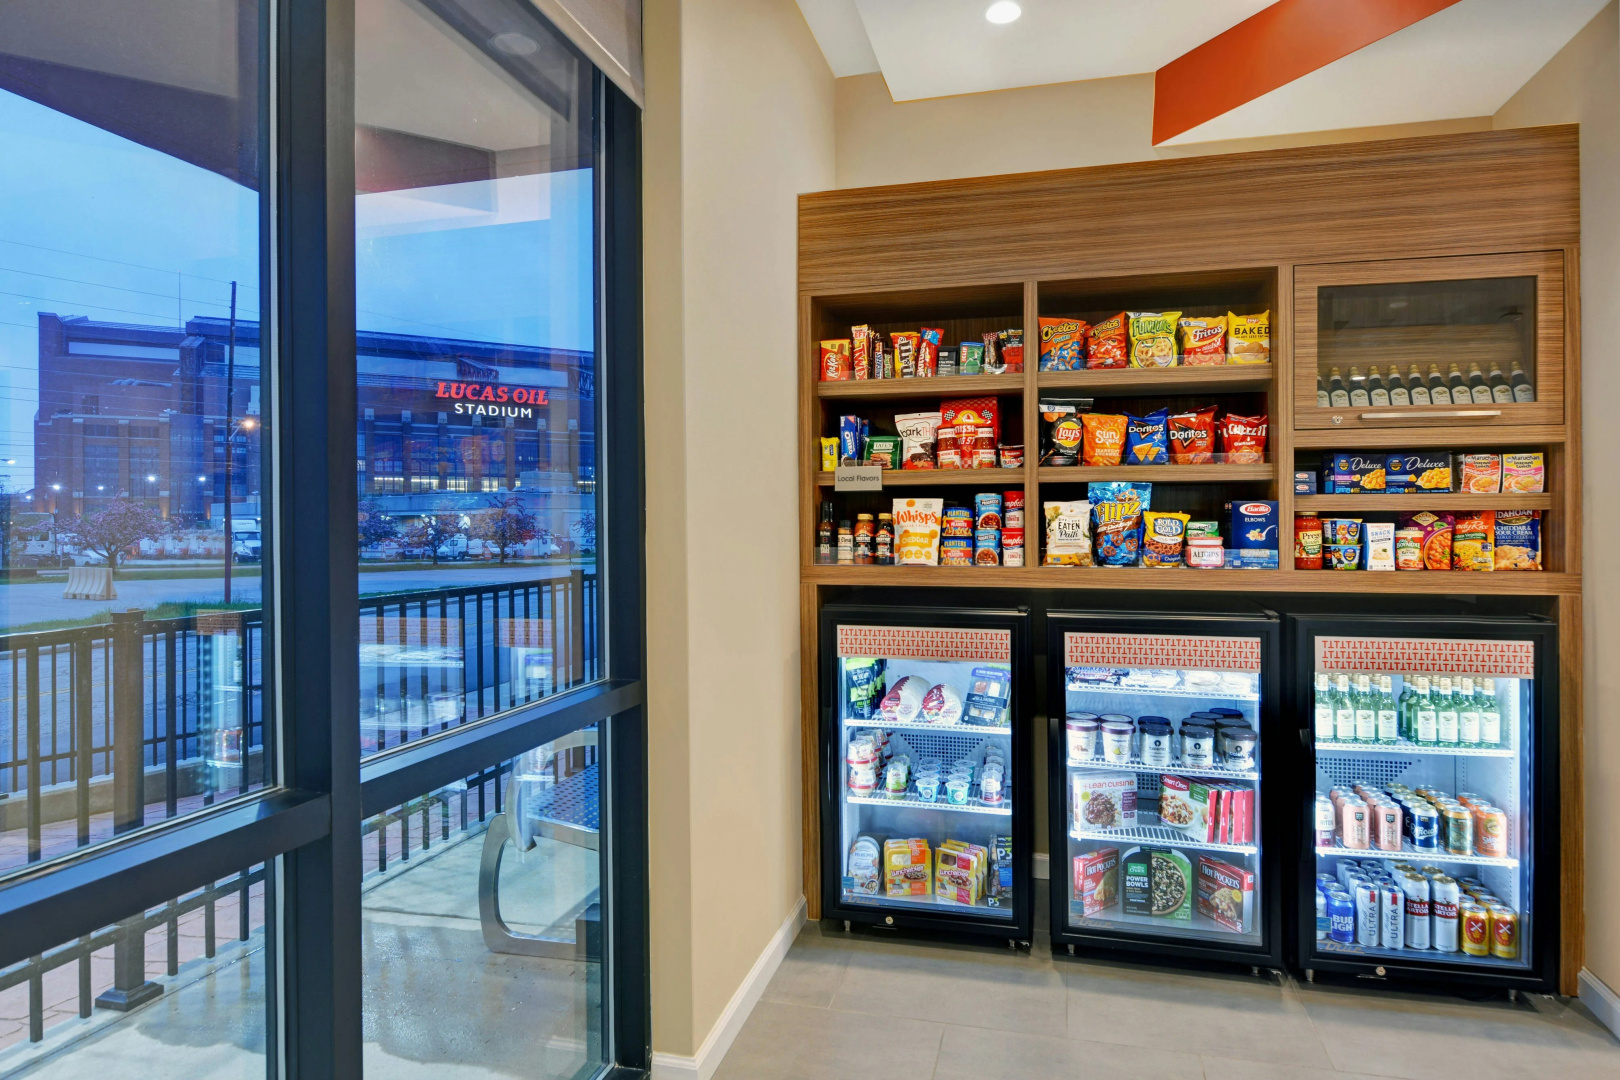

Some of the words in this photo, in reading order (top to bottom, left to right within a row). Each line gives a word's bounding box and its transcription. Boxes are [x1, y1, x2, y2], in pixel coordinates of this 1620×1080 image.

[1041, 322, 1079, 342] Cheetos
[1192, 325, 1223, 342] Fritos
[1234, 327, 1270, 335] BAKED
[436, 382, 508, 402] LUCAS
[513, 388, 549, 405] OIL
[454, 403, 532, 418] STADIUM
[1129, 423, 1164, 433] Doritos
[1058, 428, 1081, 441] Lay's
[1170, 430, 1207, 439] Doritos
[843, 431, 853, 455] OREO
[1350, 457, 1382, 471] Deluxe
[1404, 457, 1446, 471] Deluxe
[897, 510, 938, 525] Whisps
[1495, 510, 1533, 518] IDAHOAN
[1058, 521, 1081, 530] EATEN
[902, 536, 929, 544] CHEDDAR
[997, 848, 1012, 860] P3
[1086, 865, 1097, 876] HOT
[1202, 865, 1213, 877] HOT
[1213, 870, 1240, 889] POCKETS
[988, 898, 1000, 907] P3
[1333, 914, 1353, 923] BUD
